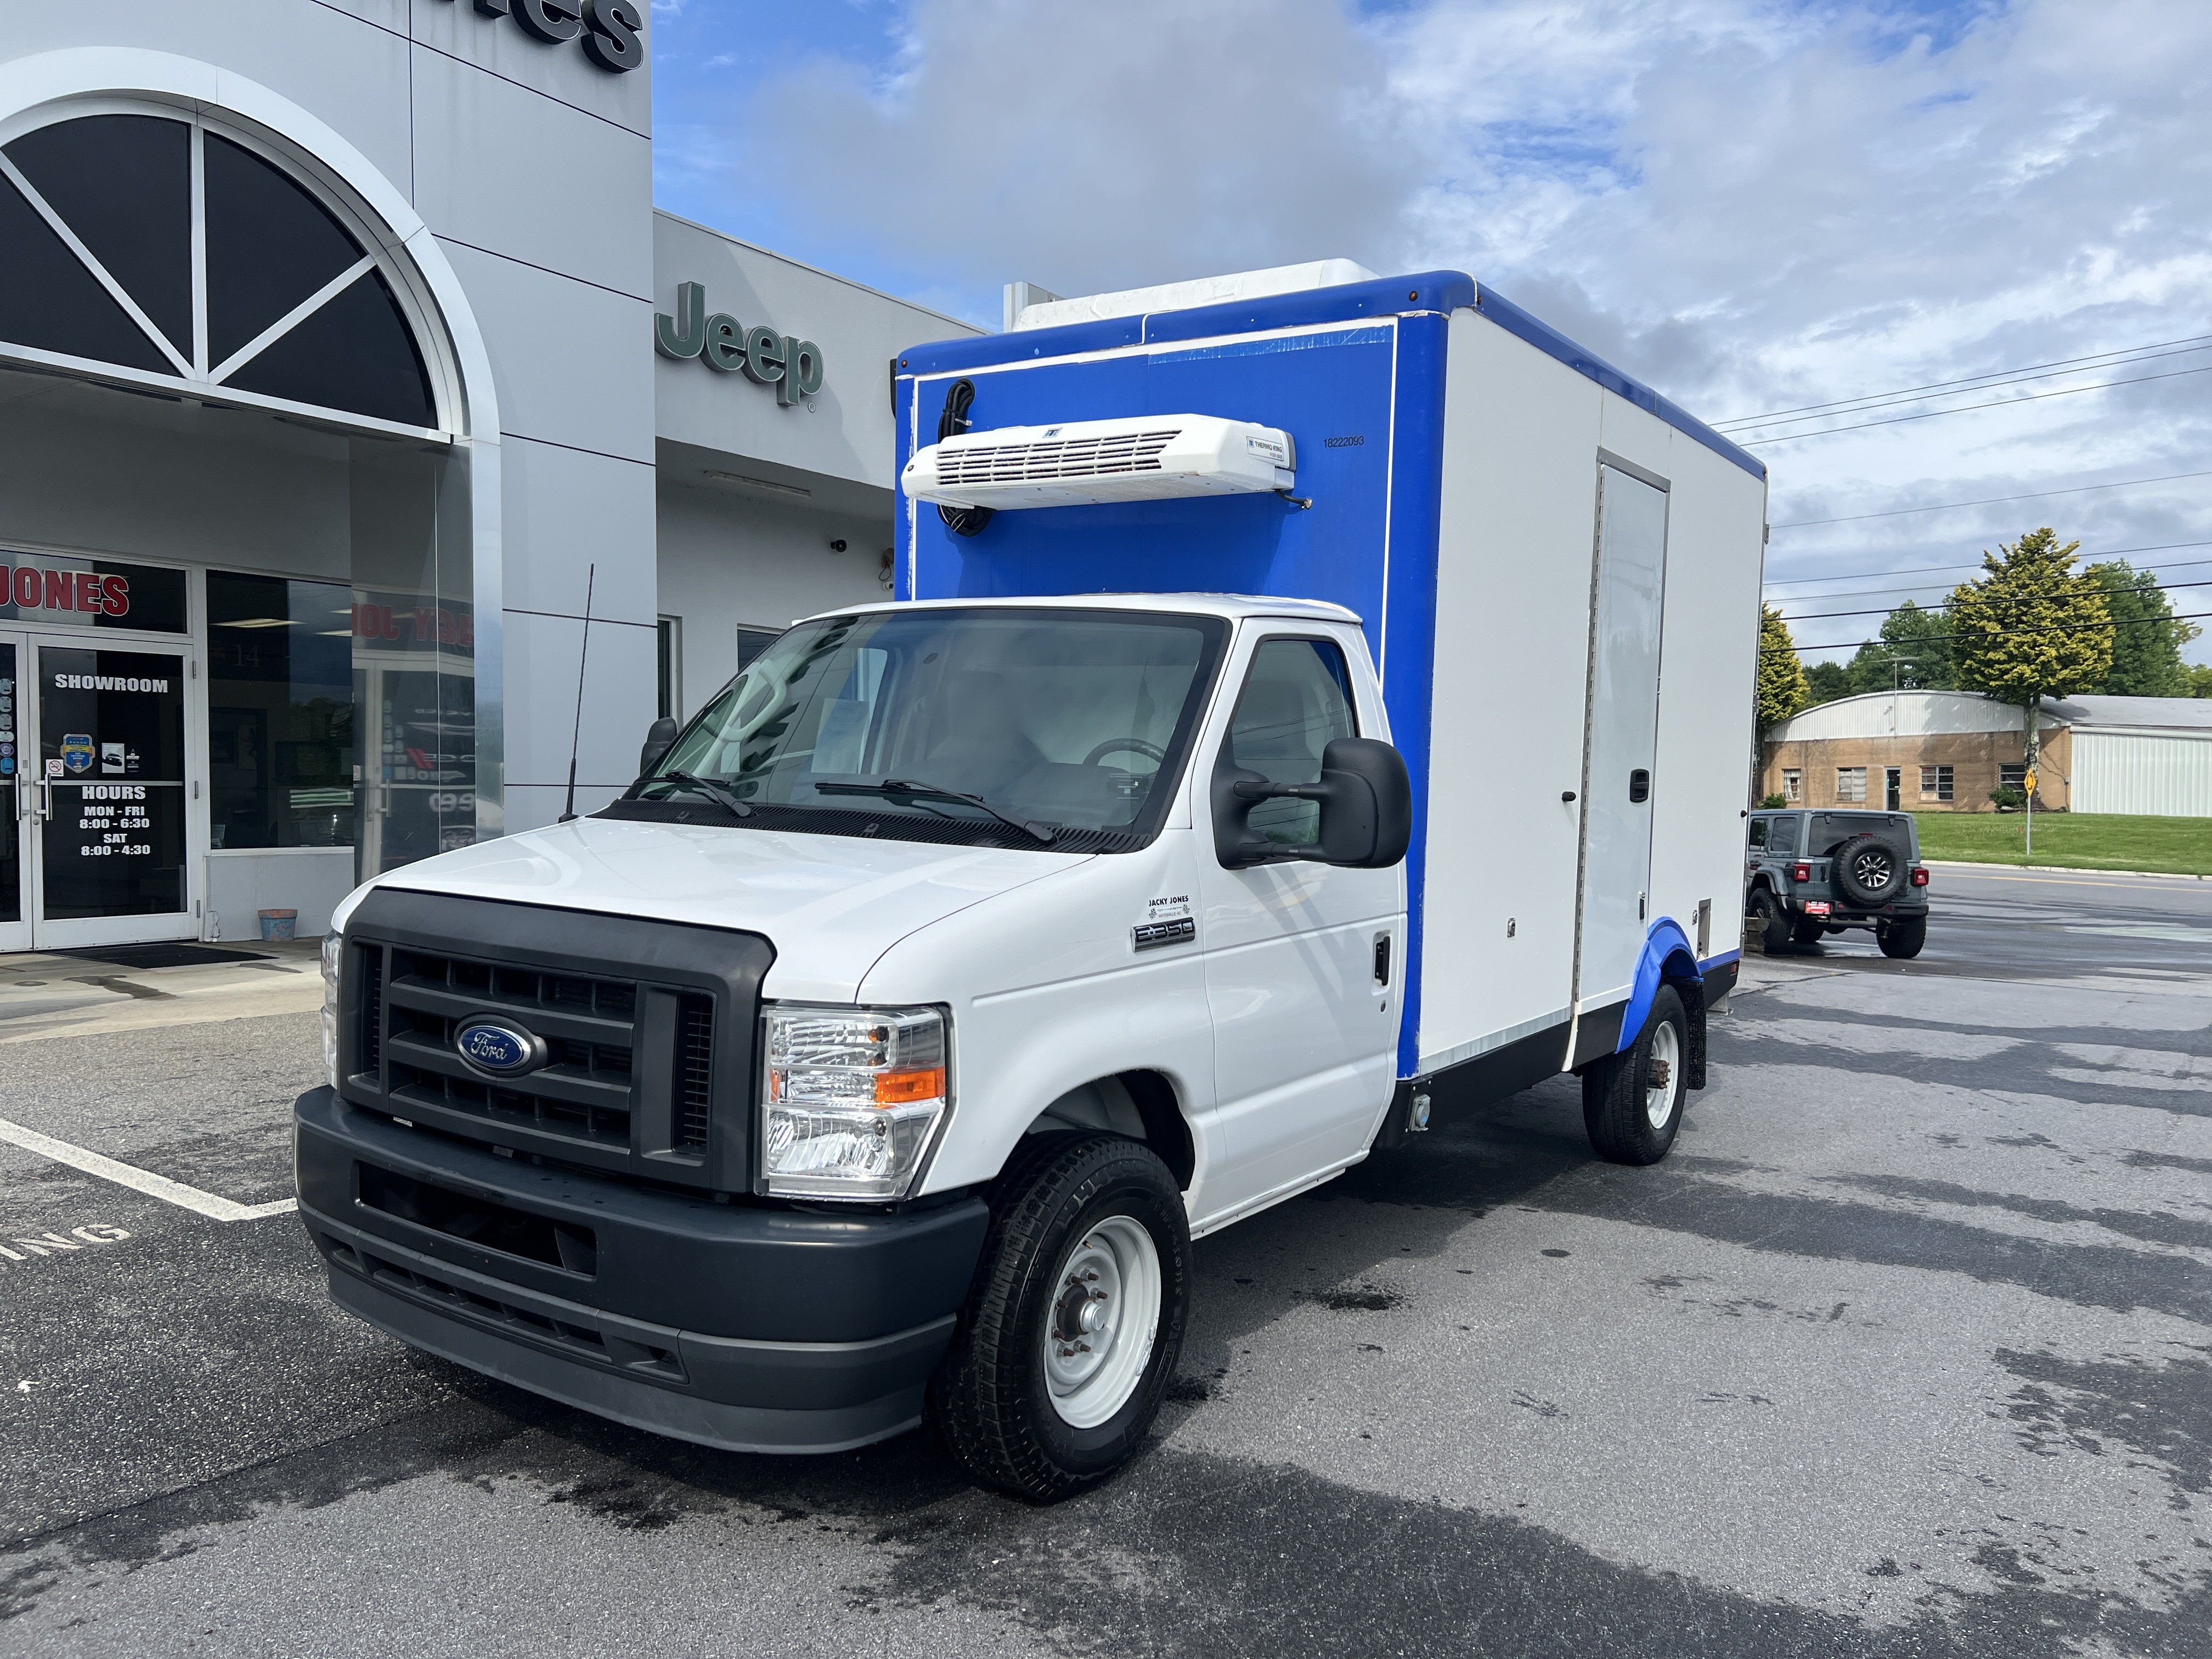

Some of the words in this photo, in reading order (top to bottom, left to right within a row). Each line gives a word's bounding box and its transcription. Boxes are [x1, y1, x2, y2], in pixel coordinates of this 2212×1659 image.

[655, 281, 823, 407] Jeep
[1255, 441, 1272, 451] THERMO
[1273, 445, 1283, 453] KING
[1323, 436, 1364, 448] 18222093
[55, 674, 168, 693] SHOWROOM
[82, 786, 146, 799] HOURS
[84, 806, 114, 816] MON
[125, 806, 145, 816] FRI
[79, 819, 110, 828] 8:00
[120, 818, 150, 828] 6:30
[103, 833, 127, 843] SAT
[81, 845, 111, 855] 8:00
[121, 845, 150, 855] 4:30
[1148, 898, 1167, 907] JACKY
[1170, 895, 1189, 904] JONES
[471, 1031, 509, 1060] Ford
